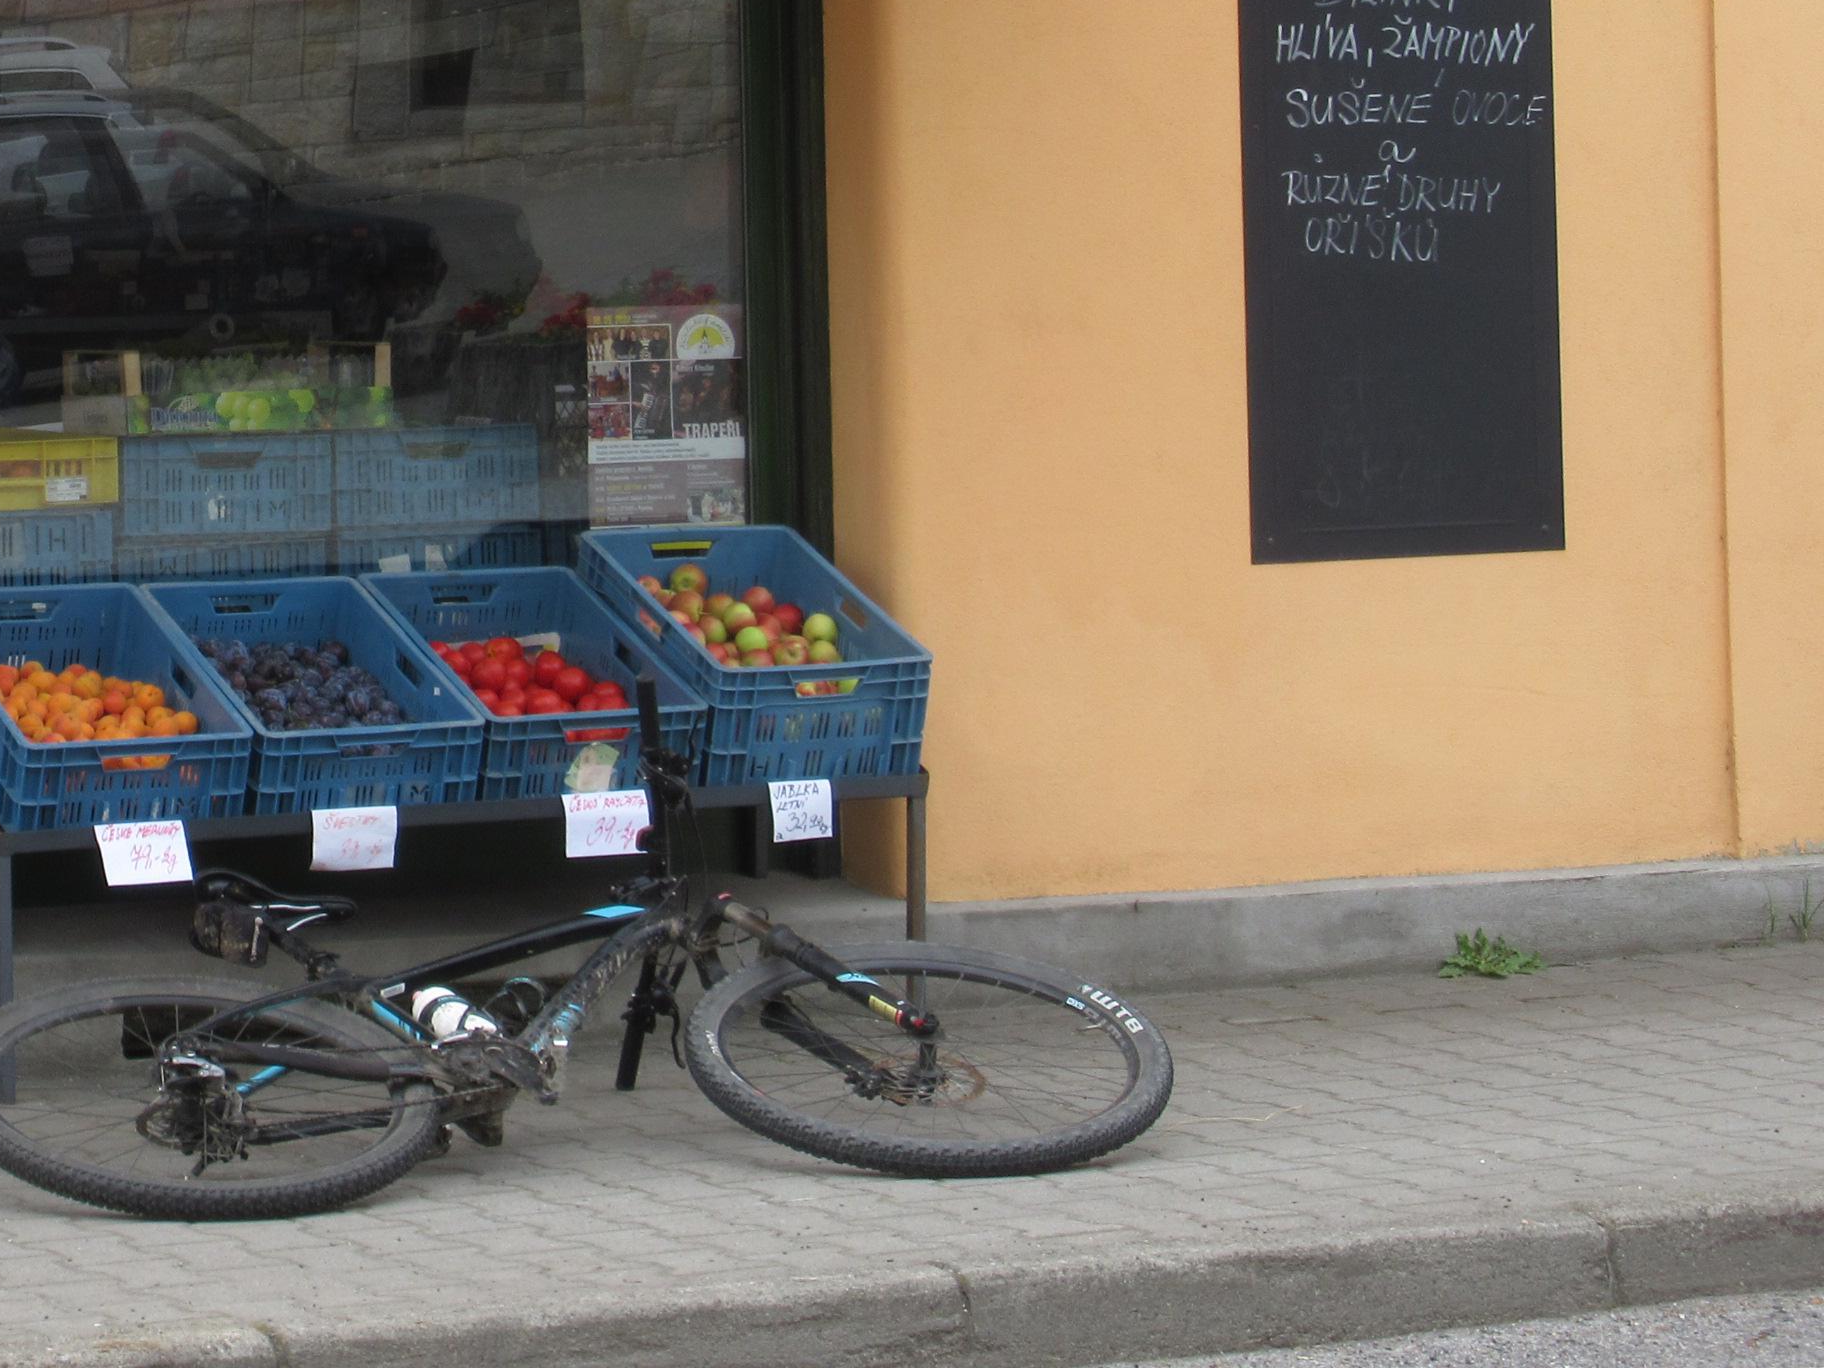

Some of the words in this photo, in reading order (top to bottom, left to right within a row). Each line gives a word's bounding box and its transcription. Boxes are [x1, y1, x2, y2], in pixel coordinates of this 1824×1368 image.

[1380, 13, 1536, 66] ŽAMPIONY
[1285, 68, 1446, 129] SUŠENÉ
[1452, 89, 1547, 126] OVOCE
[1396, 173, 1502, 213] DRUHY
[773, 783, 820, 800] JABLKA
[1090, 990, 1145, 1034] WTB
